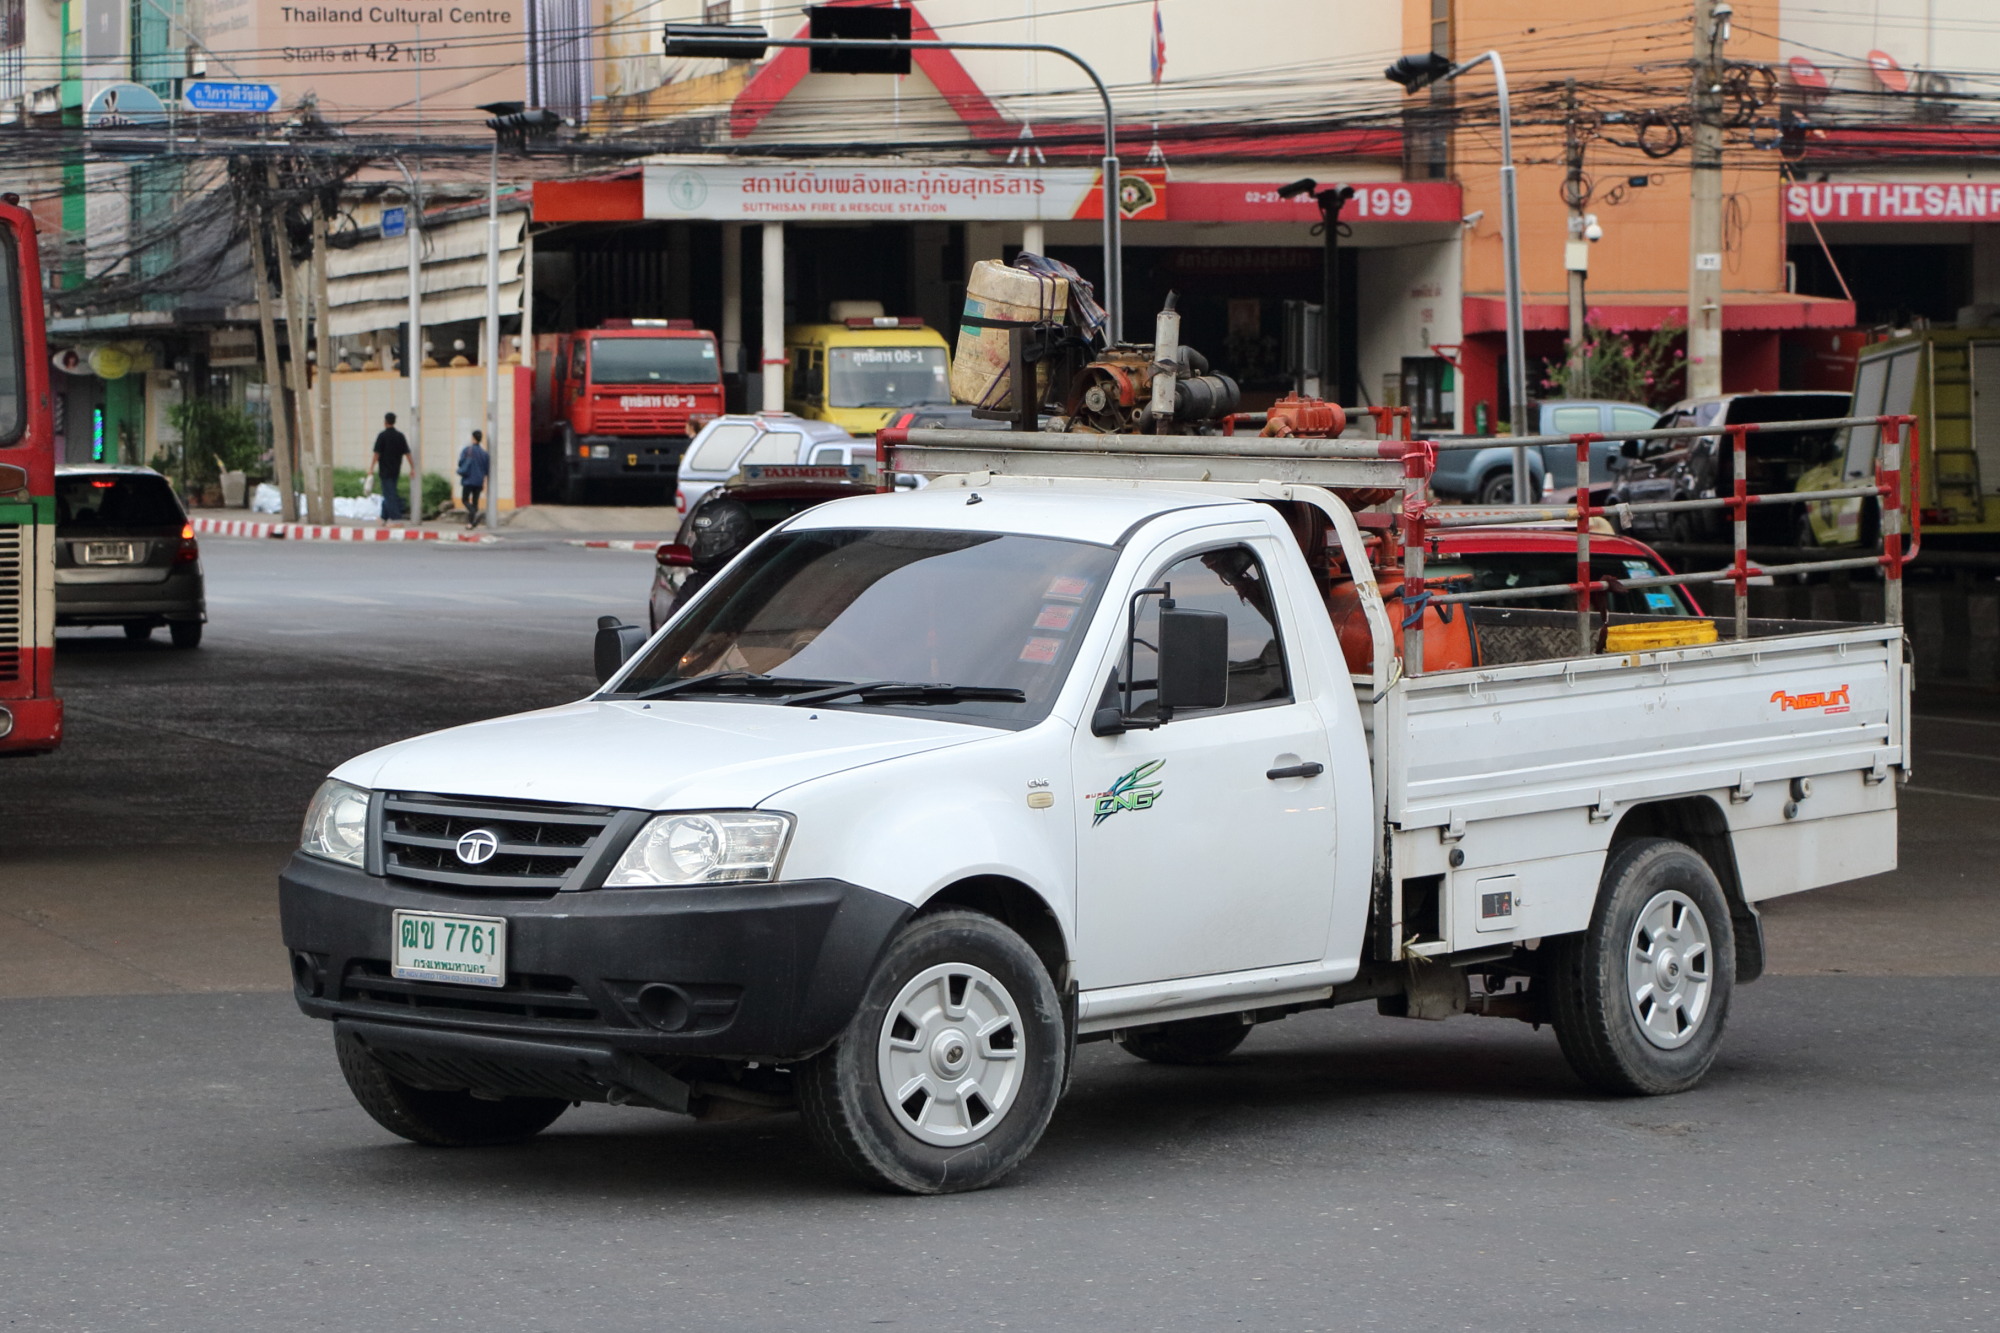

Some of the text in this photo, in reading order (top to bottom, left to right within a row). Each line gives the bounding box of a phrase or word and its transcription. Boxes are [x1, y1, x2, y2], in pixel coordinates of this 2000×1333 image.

[281, 7, 512, 23] Thailand Cultural Centre
[283, 46, 336, 63] Starts
[342, 47, 358, 63] at
[366, 43, 399, 62] 4.2
[742, 202, 807, 213] SUTTHISAN
[811, 202, 837, 213] FIRE
[849, 202, 895, 213] RESCUE
[899, 202, 948, 213] STATION
[1354, 188, 1412, 216] 199
[1787, 184, 1987, 217] SUTTHISAN
[663, 395, 696, 408] 05-2
[763, 466, 849, 478] TAXI-METER
[1094, 789, 1154, 815] CNG
[444, 922, 496, 955] 7761
